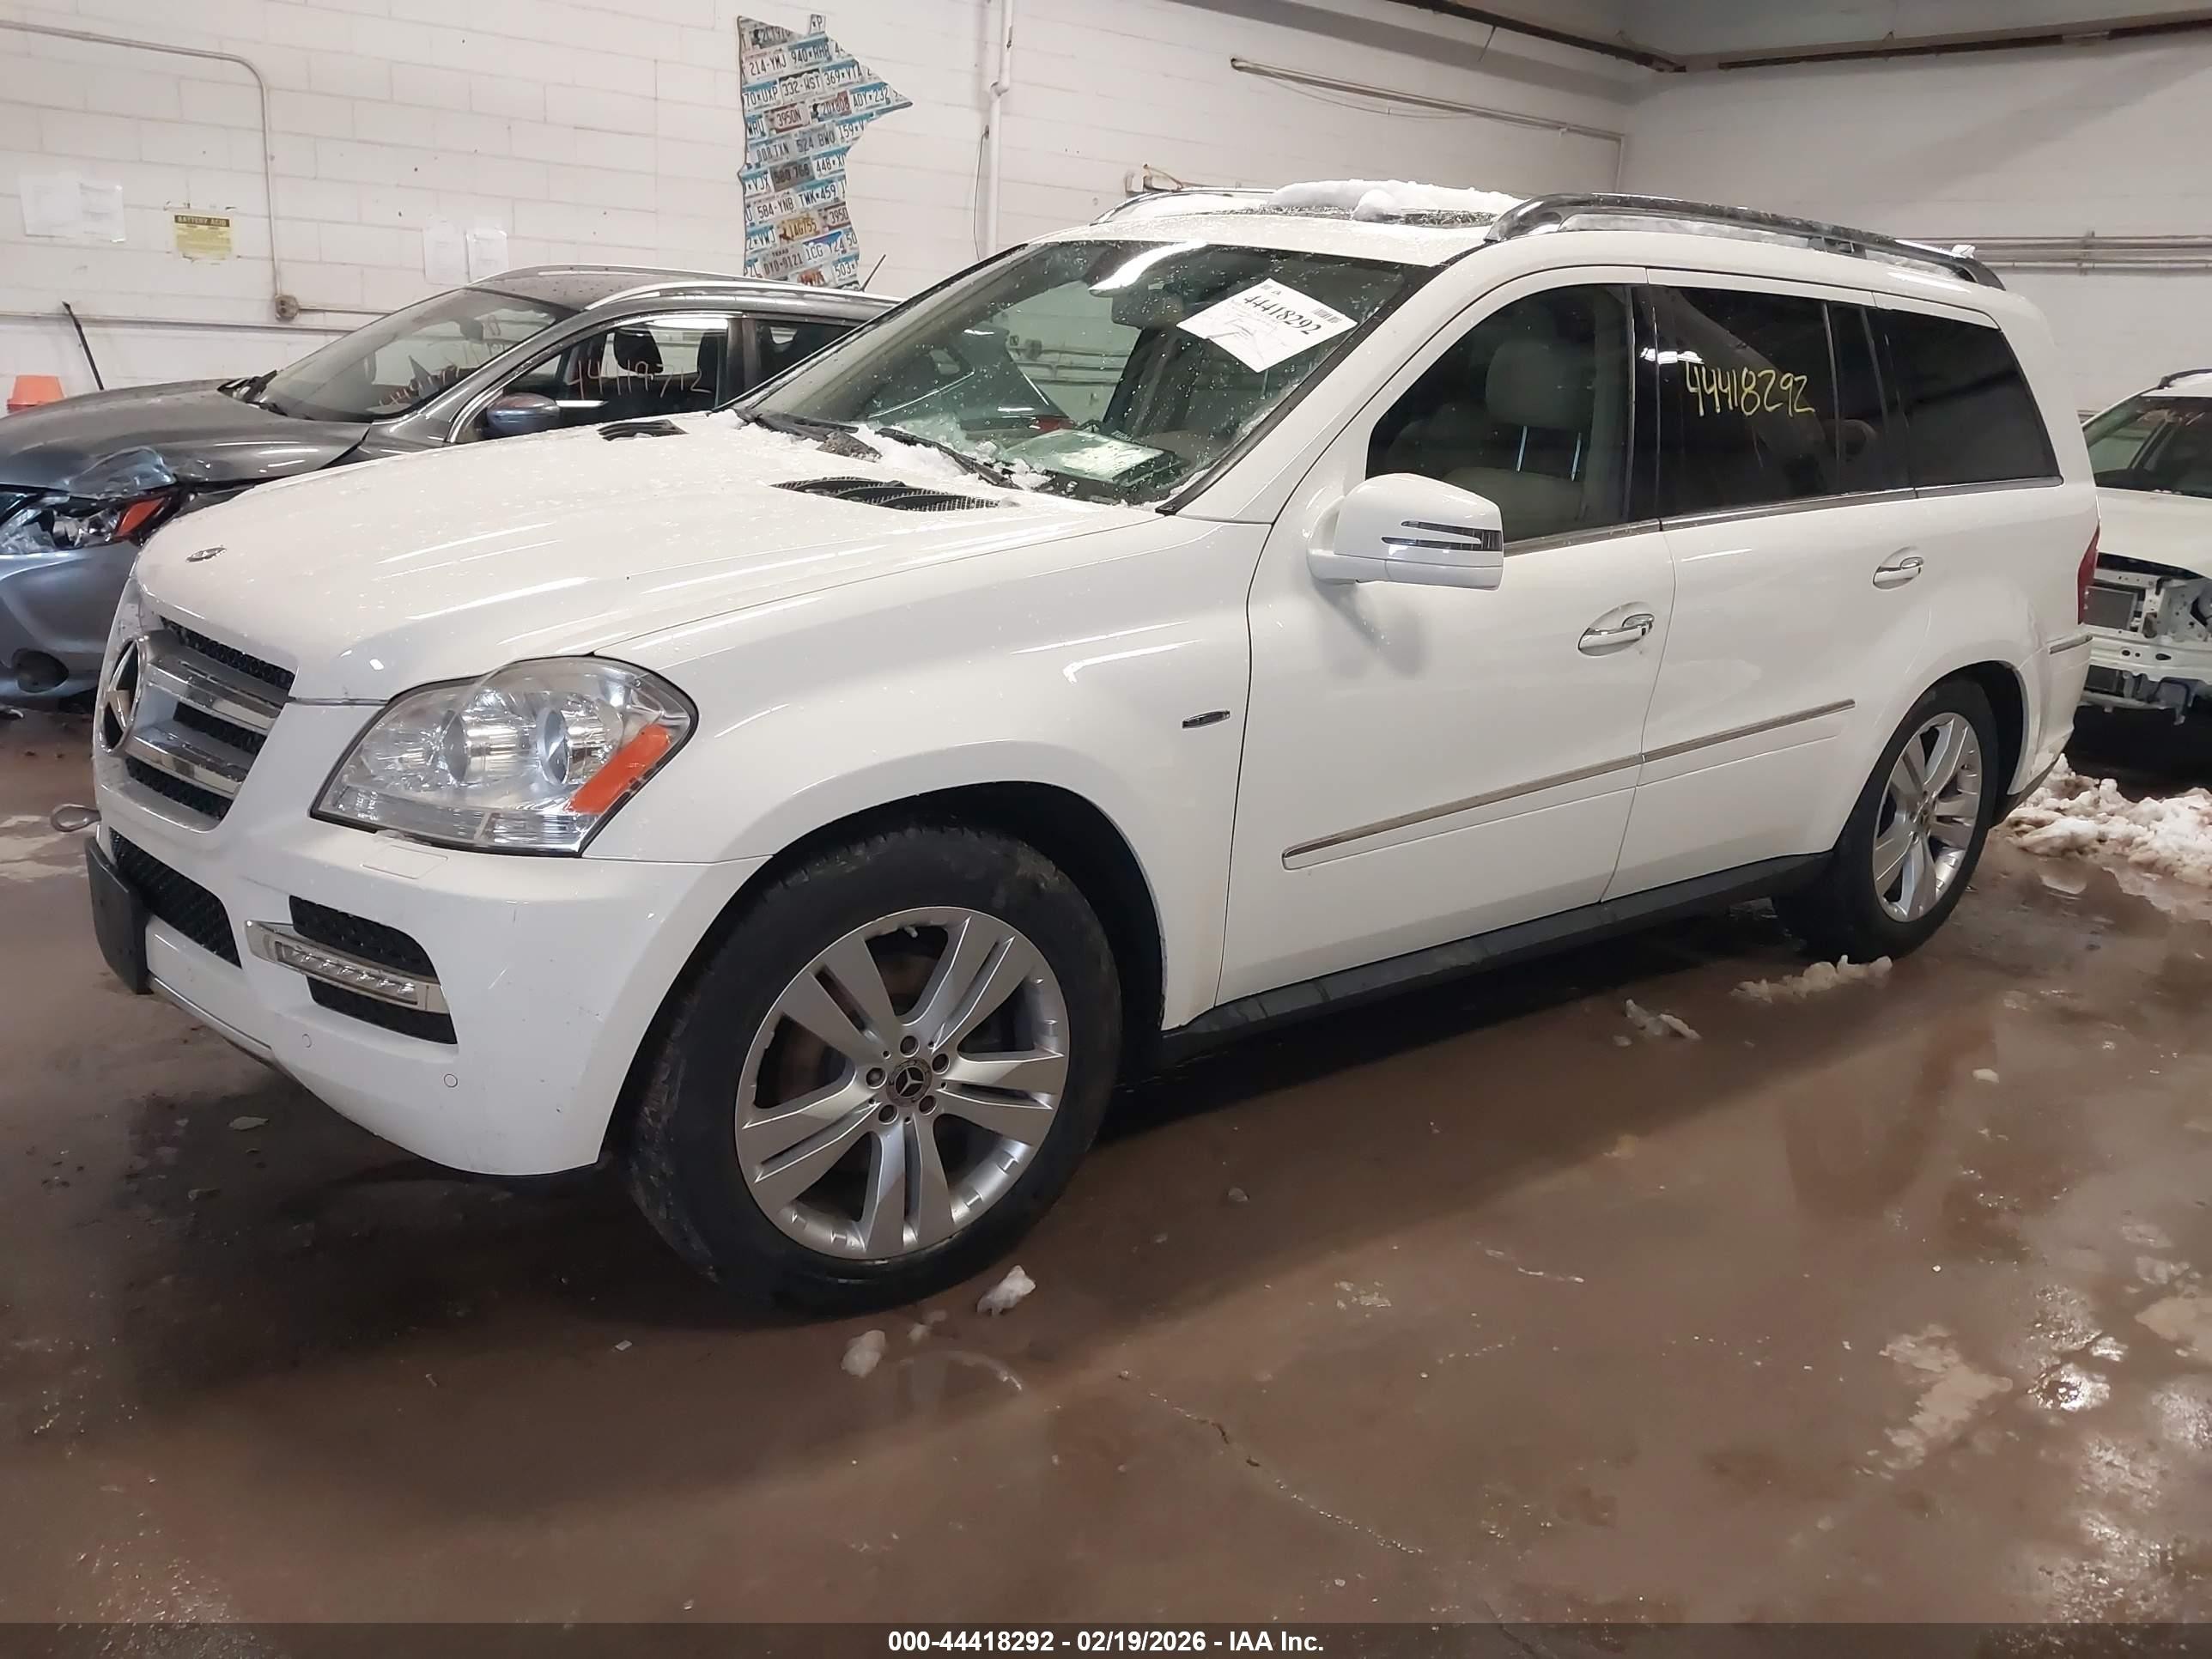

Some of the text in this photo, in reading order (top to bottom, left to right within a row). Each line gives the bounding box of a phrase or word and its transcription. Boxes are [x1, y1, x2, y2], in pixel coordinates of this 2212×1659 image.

[210, 218, 227, 227] ACID
[1243, 295, 1322, 336] 44418292
[1685, 361, 1816, 417] 44418292
